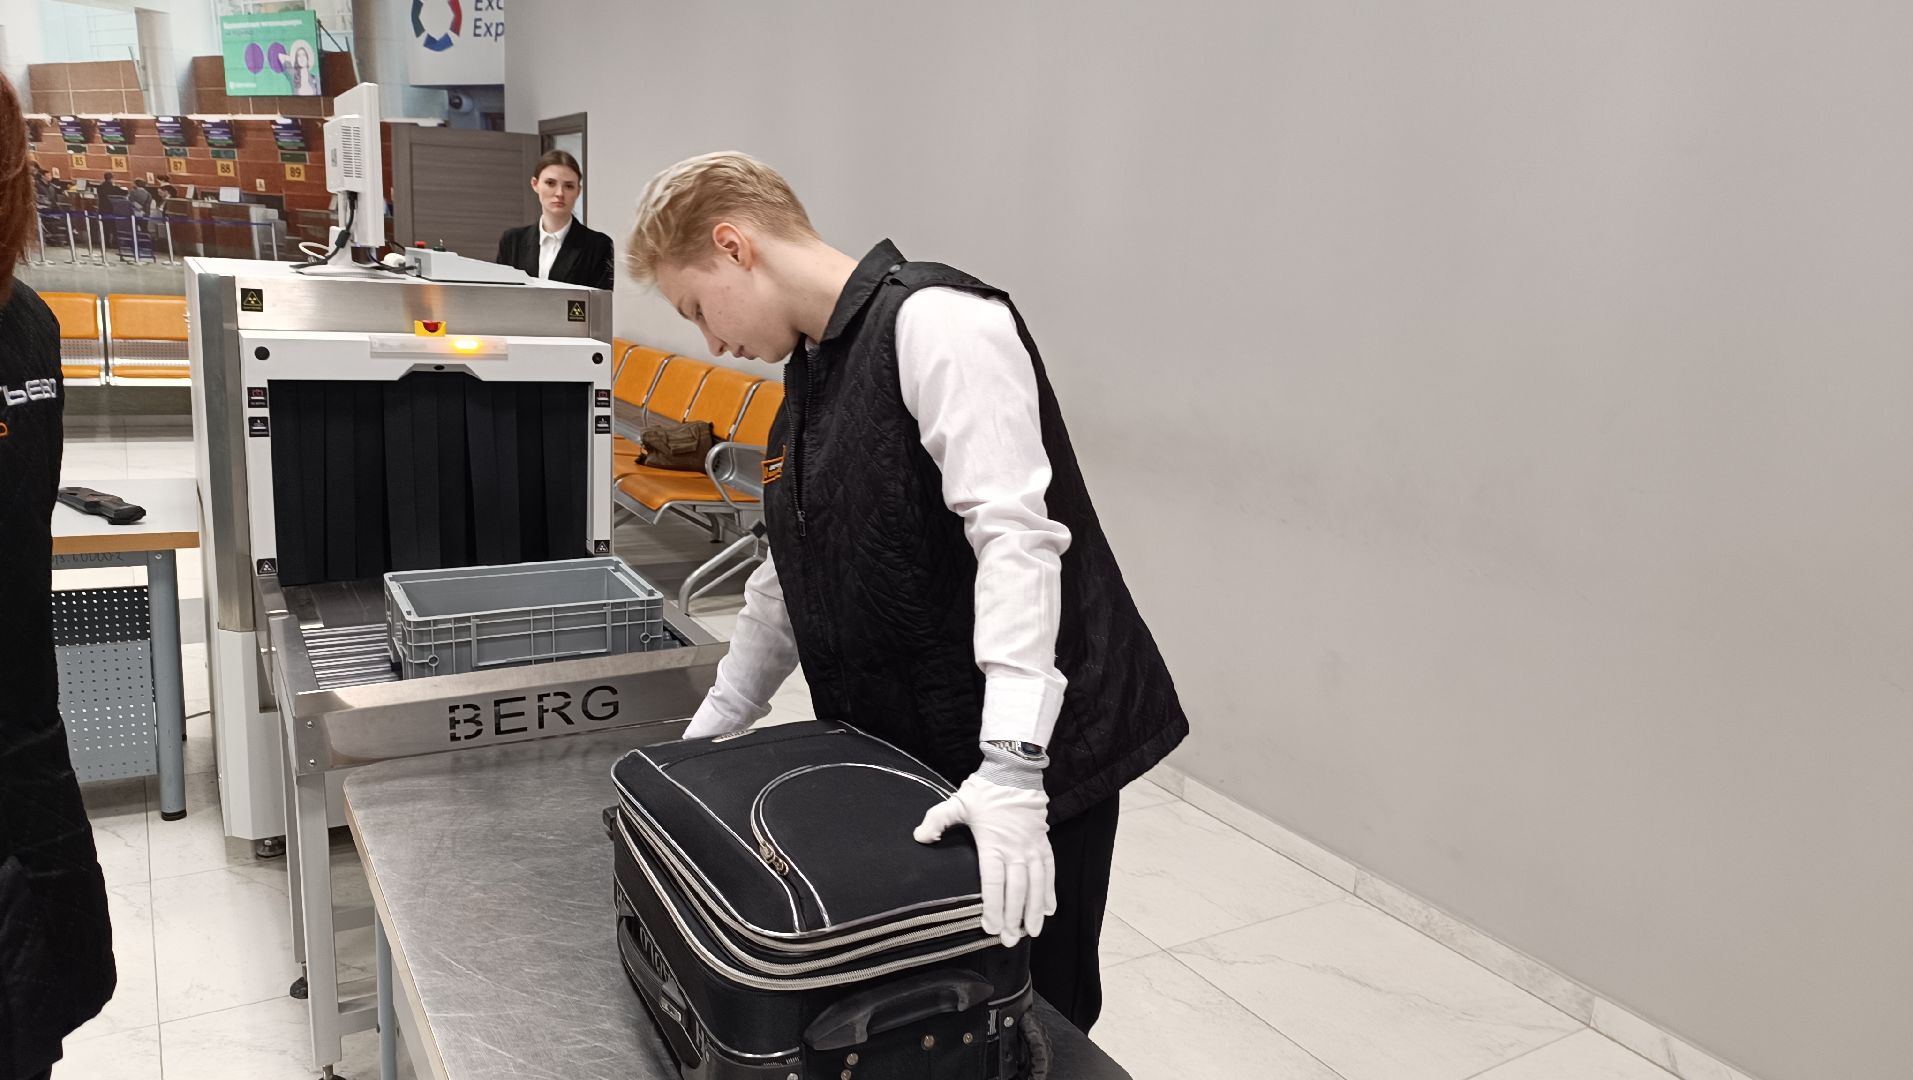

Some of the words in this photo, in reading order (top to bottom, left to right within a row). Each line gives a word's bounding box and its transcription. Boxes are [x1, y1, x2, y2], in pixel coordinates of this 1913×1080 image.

[473, 18, 504, 42] Exp
[173, 161, 182, 171] 87
[220, 163, 231, 174] 88
[290, 167, 300, 178] 89
[449, 686, 619, 742] BERG
